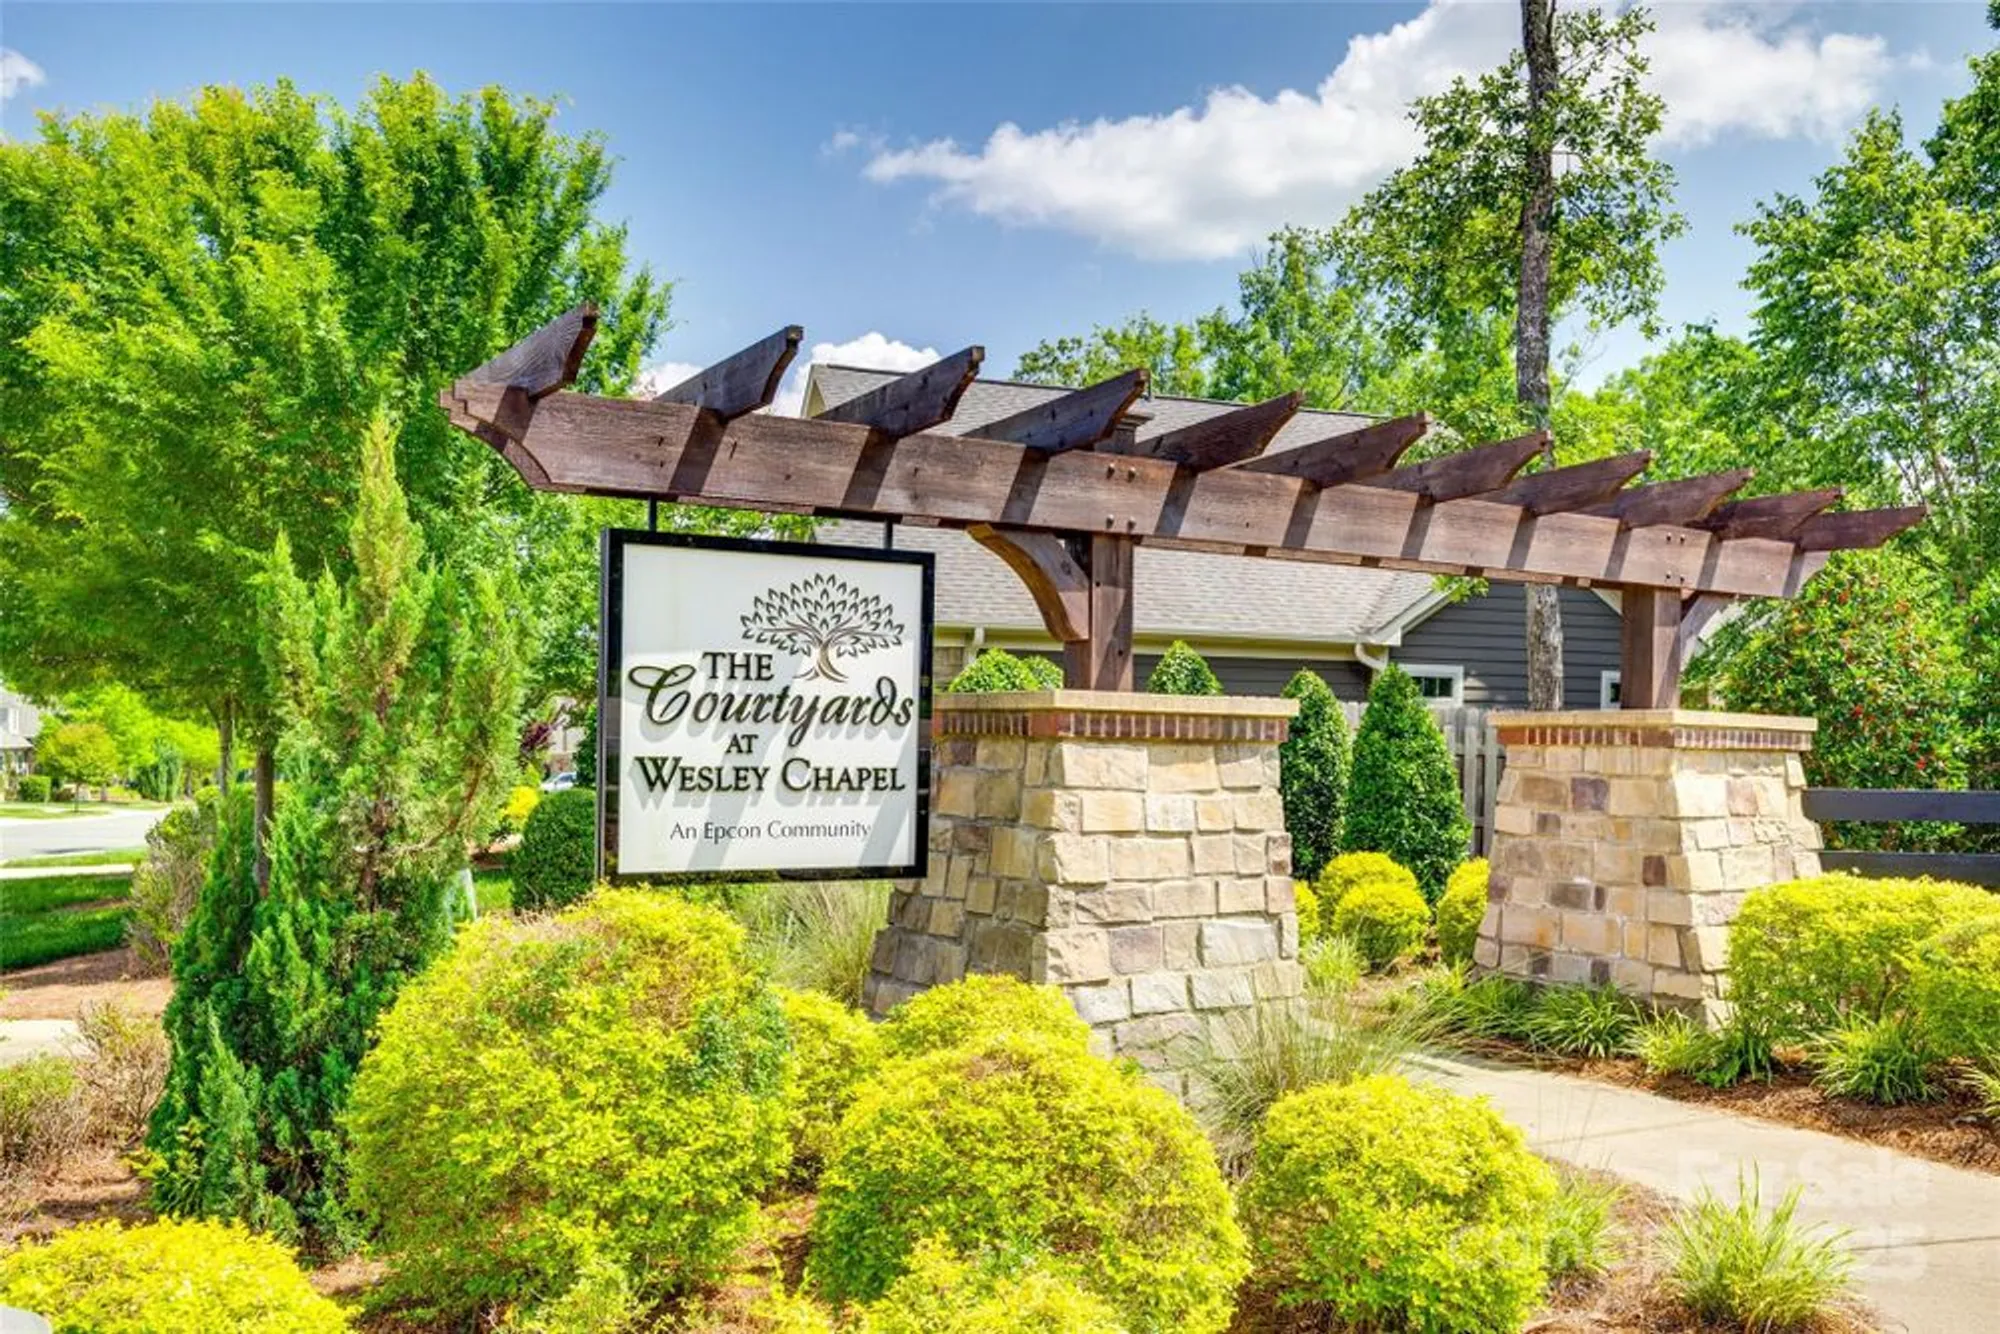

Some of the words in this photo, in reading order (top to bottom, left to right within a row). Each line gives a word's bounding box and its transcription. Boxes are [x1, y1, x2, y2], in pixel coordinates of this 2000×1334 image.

[702, 651, 774, 682] THE
[628, 664, 914, 747] Courtyards
[725, 733, 759, 755] AT
[633, 756, 770, 793] WESLEY
[781, 757, 906, 793] CHAPEL
[669, 821, 697, 840] An
[703, 821, 761, 844] Epcon
[767, 819, 872, 840] Community
